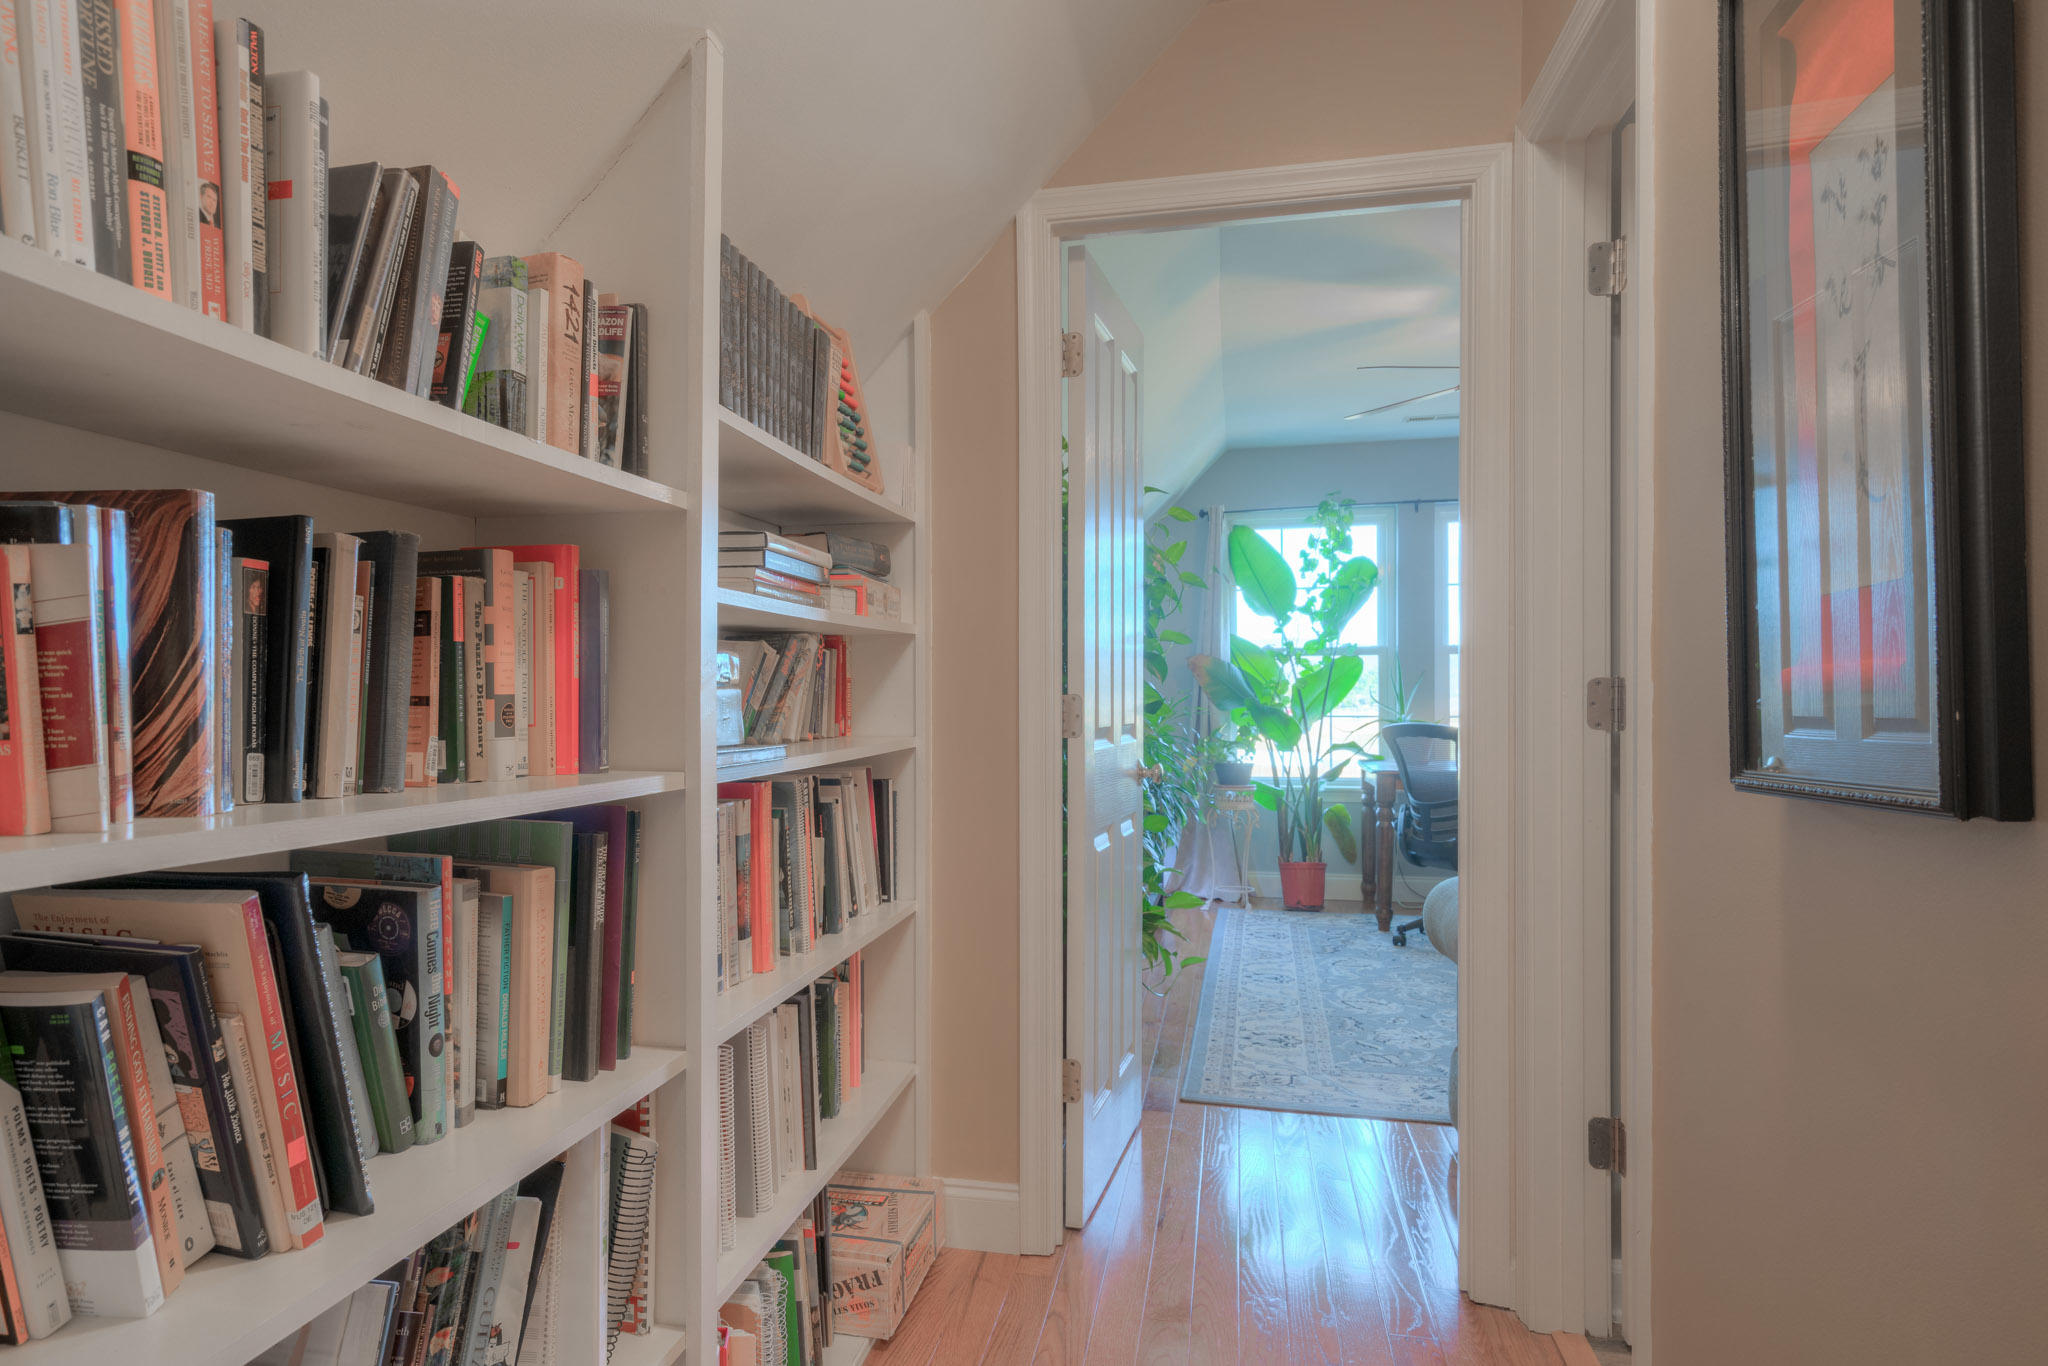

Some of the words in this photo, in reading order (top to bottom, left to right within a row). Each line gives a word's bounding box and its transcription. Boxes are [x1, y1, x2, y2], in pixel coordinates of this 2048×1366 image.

[79, 0, 98, 89] ORTUNE
[199, 14, 212, 80] HEART
[250, 31, 259, 76] WALTON
[201, 86, 214, 109] TO
[250, 82, 263, 105] THE
[202, 112, 217, 175] SERVE
[47, 172, 60, 200] Ron
[251, 150, 266, 228] MANAGEMENT
[49, 205, 62, 237] Blue
[73, 198, 83, 242] EDELMAN
[140, 191, 151, 234] STEPHEN
[152, 195, 161, 229] STEVEN
[142, 238, 152, 247] J.
[155, 242, 164, 273] LEVITT
[252, 227, 267, 274] METHOD
[516, 294, 525, 329] Daily
[562, 284, 581, 345] 1421
[598, 317, 624, 327] AZON
[516, 329, 525, 365] Walk
[598, 327, 623, 336] DLIFE
[521, 582, 529, 601] THE
[474, 601, 482, 628] The
[475, 632, 483, 679] Puzzle
[476, 683, 484, 759] Dictionary
[32, 912, 50, 922] The
[51, 912, 98, 925] Enjoyment
[99, 914, 110, 924] of
[430, 900, 441, 930] Here
[426, 930, 441, 975] Comes
[122, 993, 137, 1050] FINDING
[424, 994, 441, 1030] Night
[239, 1043, 249, 1058] THE
[257, 953, 265, 970] The
[261, 971, 273, 1015] Enjoyment
[270, 1029, 297, 1120] MUSIC
[132, 1050, 143, 1083] GOD
[222, 1071, 231, 1088] The
[241, 1061, 253, 1084] LITTLE
[96, 1006, 110, 1044] CAN
[106, 1050, 125, 1119] POETRY
[118, 1125, 141, 1204] MATTER?
[137, 1086, 146, 1103] AT
[224, 1090, 236, 1112] Little
[140, 1103, 158, 1166] HARVARD
[230, 1114, 242, 1143] Prince
[7, 1129, 21, 1188] INTRODUCTION
[23, 1211, 36, 1255] ANTHOLOGY
[12, 1105, 27, 1146] POEMS
[23, 1157, 37, 1195] POETS
[34, 1205, 49, 1248] POETRY
[166, 1161, 176, 1182] East
[176, 1199, 184, 1220] Eden
[157, 1196, 170, 1242] MONROE
[832, 1269, 884, 1300] FRÁG
